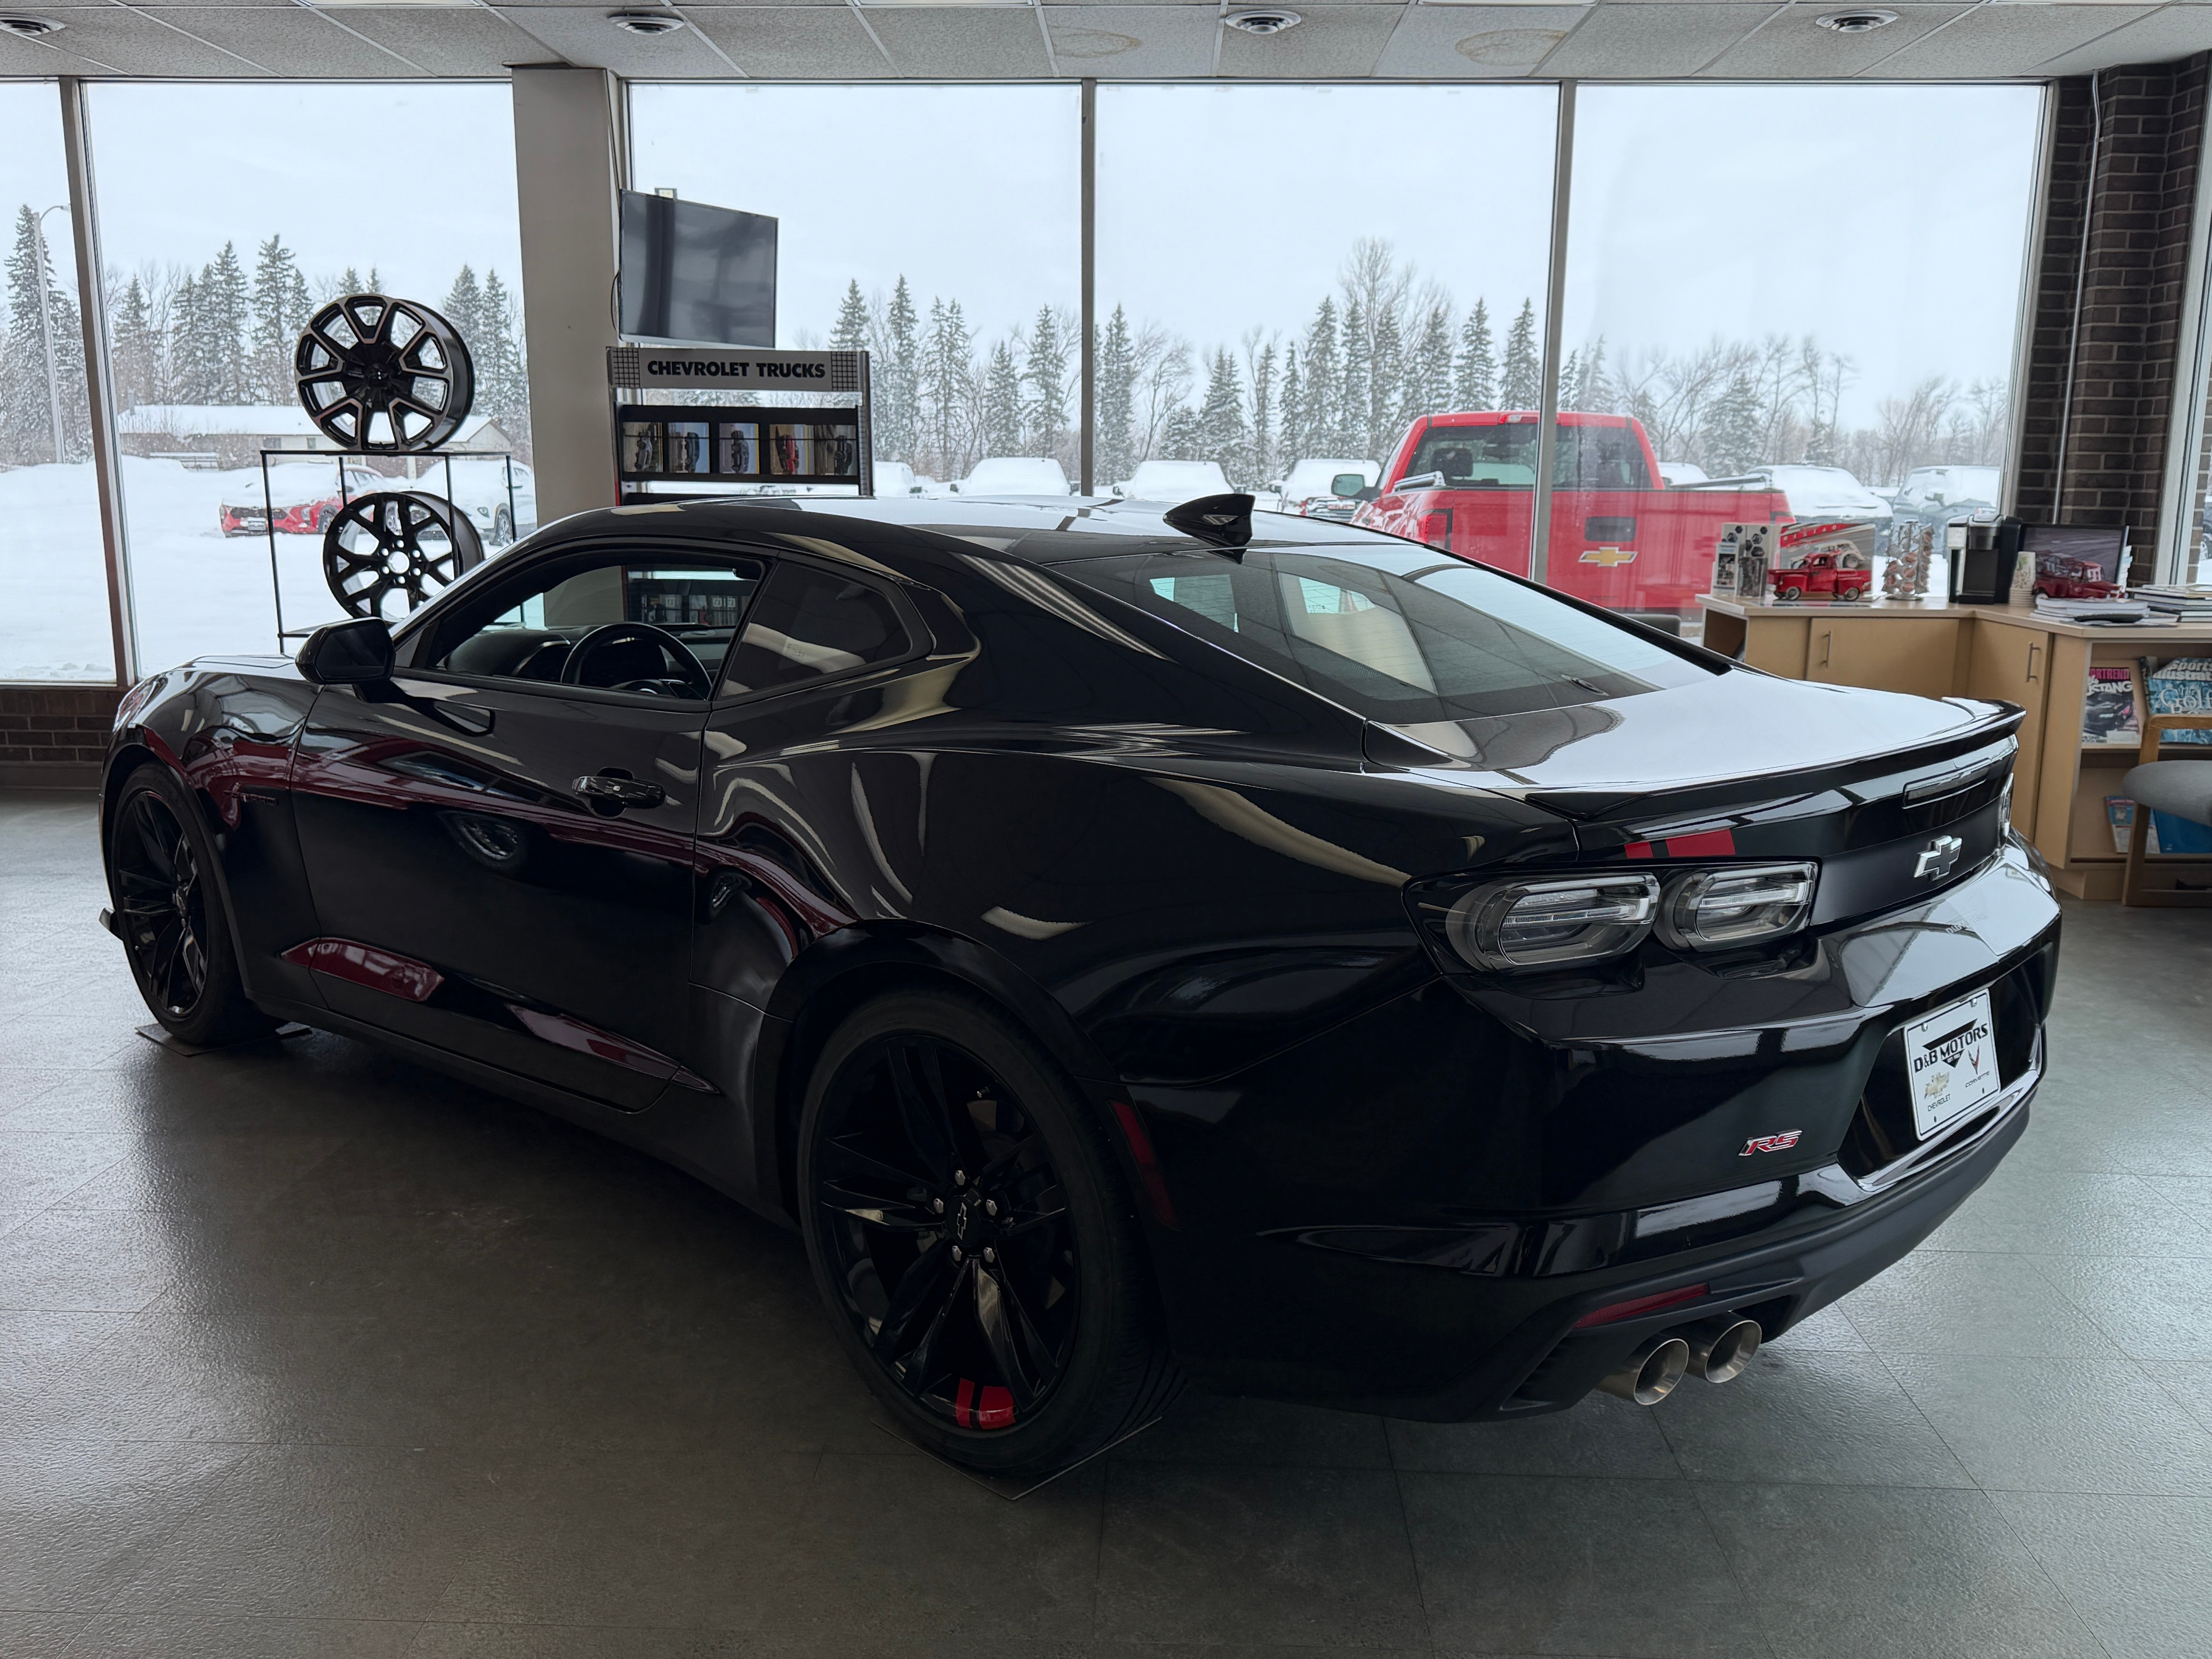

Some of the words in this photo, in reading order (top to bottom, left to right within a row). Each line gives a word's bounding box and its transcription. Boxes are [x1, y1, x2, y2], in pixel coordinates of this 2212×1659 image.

[647, 361, 750, 377] CHEVROLET
[756, 362, 826, 378] TRUCKS
[1913, 1048, 1938, 1073] D&B
[1940, 1023, 1989, 1060] MOTORS
[1965, 1070, 1990, 1088] CORVETTE
[1927, 1093, 1951, 1112] CHEVROLET
[1738, 1128, 1802, 1156] RS
